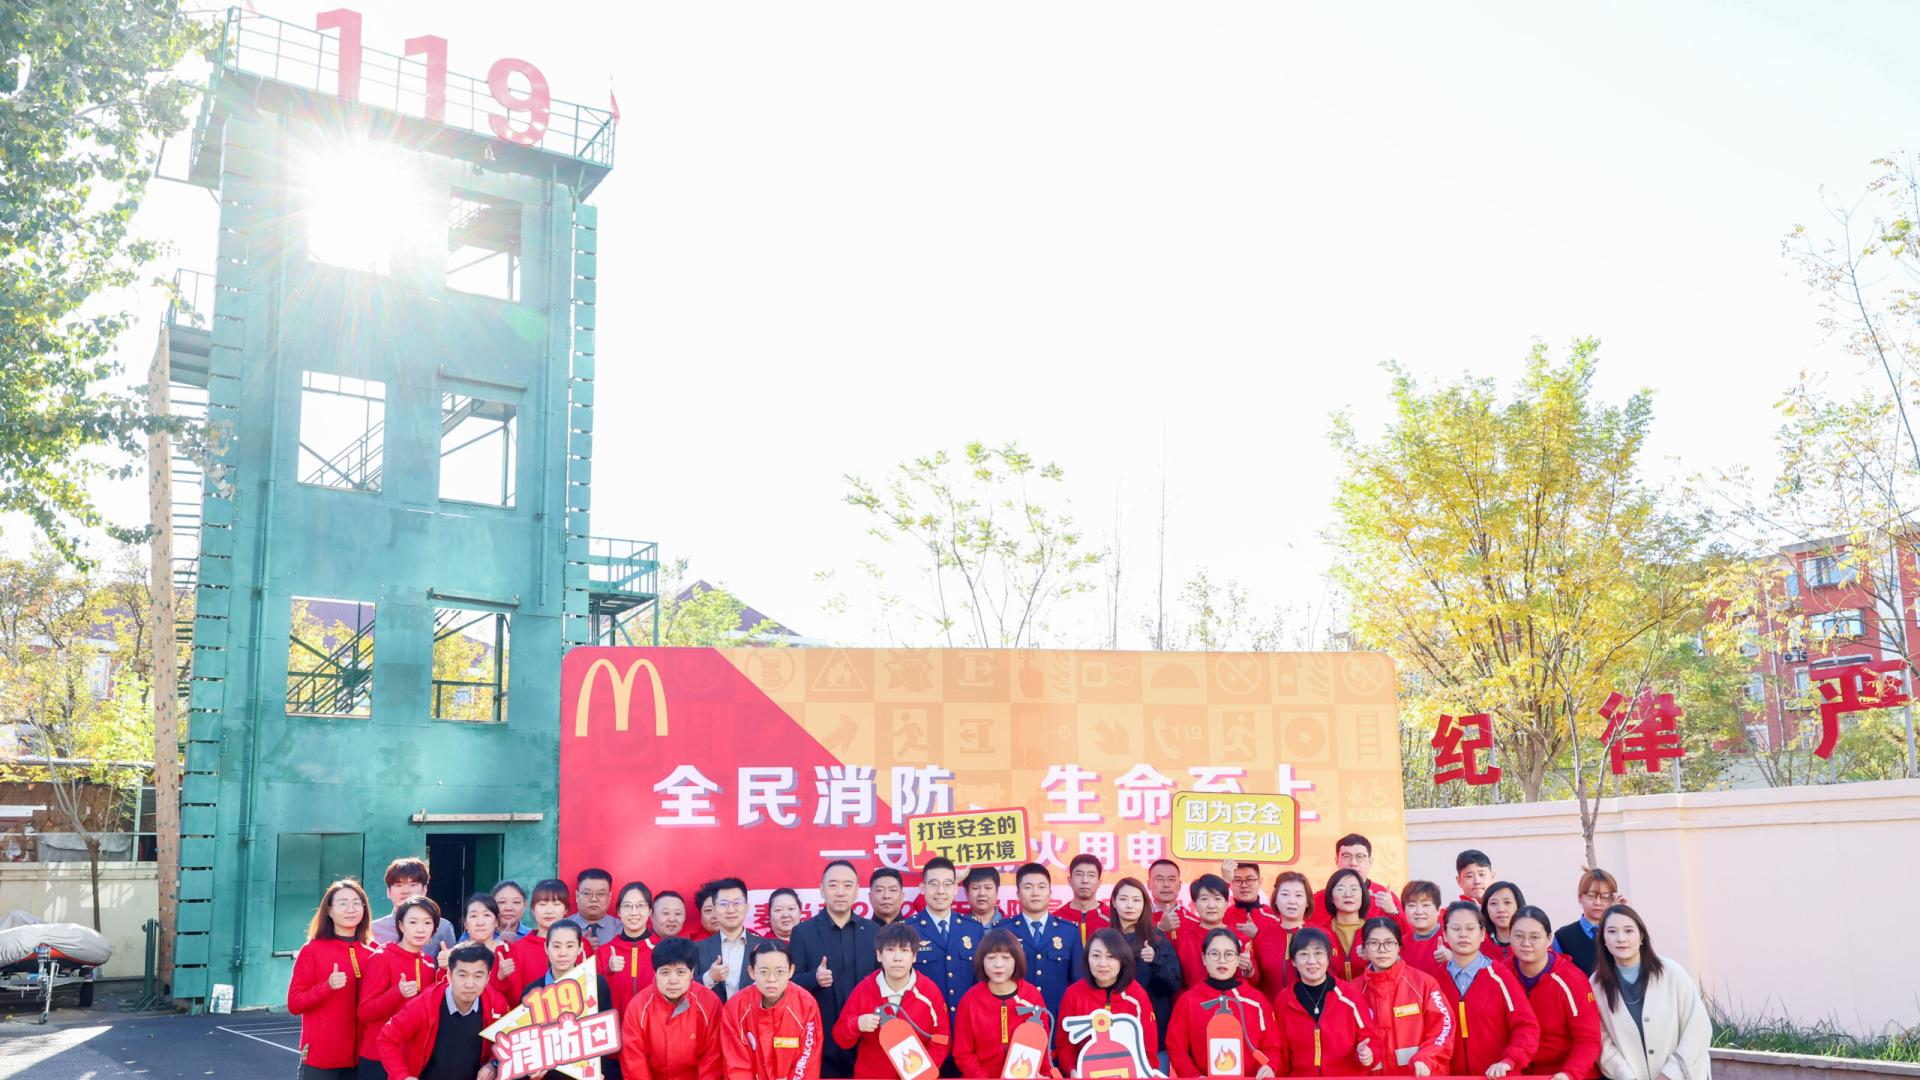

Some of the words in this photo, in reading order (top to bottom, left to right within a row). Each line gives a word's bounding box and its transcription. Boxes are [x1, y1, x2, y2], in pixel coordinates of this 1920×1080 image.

[316, 8, 551, 146] 119
[1170, 725, 1203, 741] 119
[1185, 799, 1284, 825] 因为安全
[917, 815, 1017, 841] 打造安全的
[936, 840, 1016, 863] 工作环境
[1184, 828, 1284, 855] 顾客安心
[527, 981, 582, 1025] 119
[497, 1013, 619, 1080] 消防日
